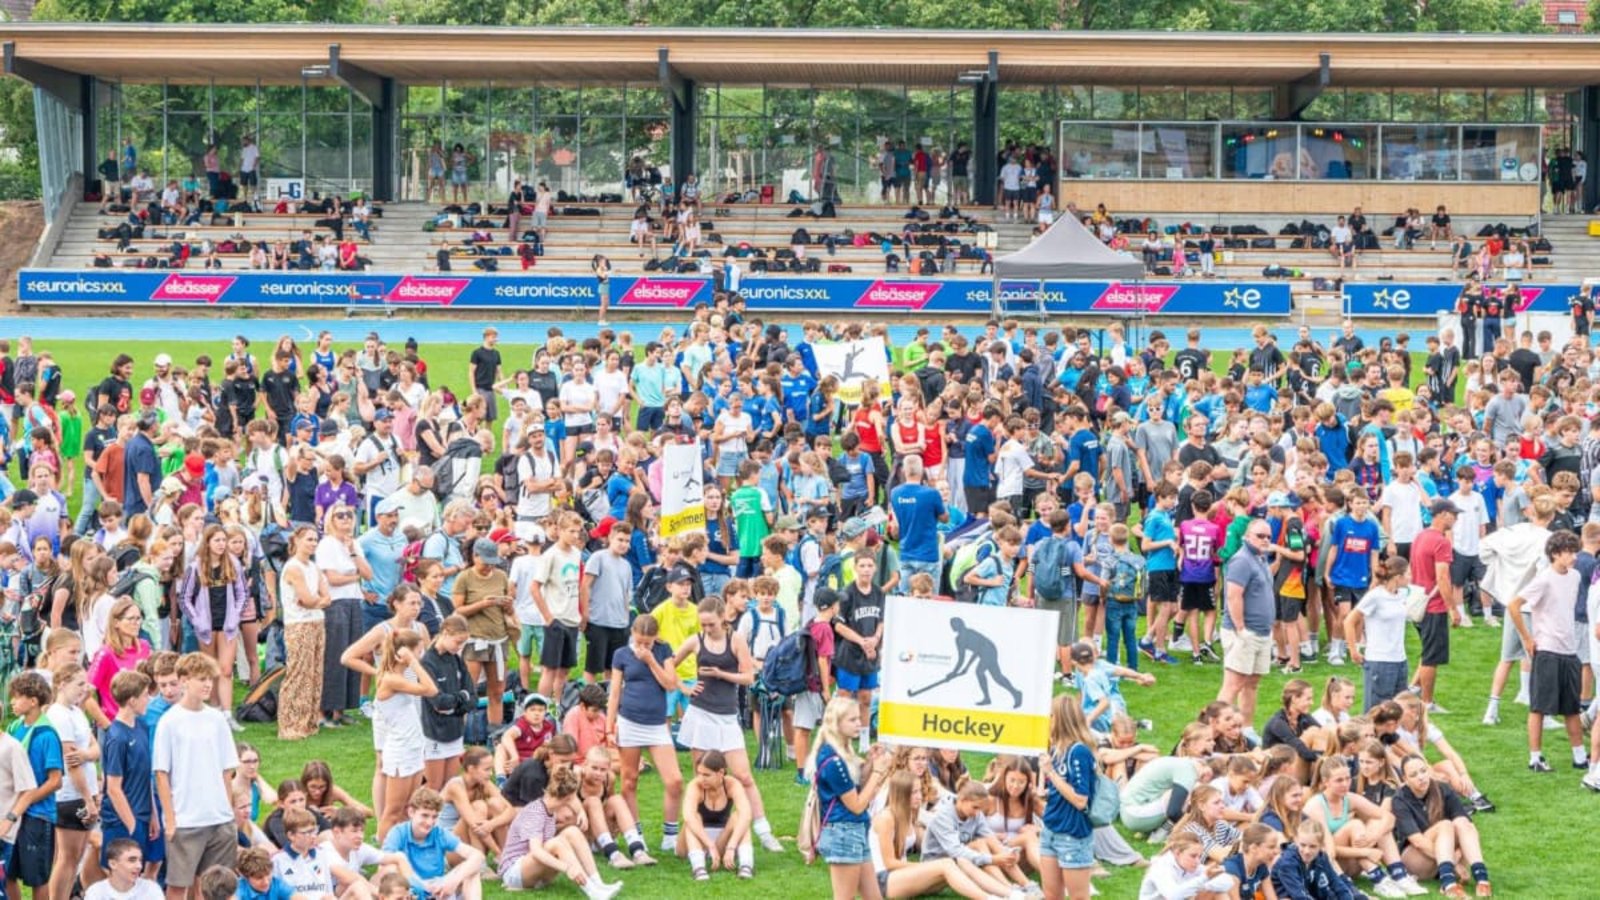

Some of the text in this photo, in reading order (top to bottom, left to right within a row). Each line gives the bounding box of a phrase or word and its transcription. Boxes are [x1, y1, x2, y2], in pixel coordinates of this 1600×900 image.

[164, 280, 220, 295] elsässer
[399, 282, 456, 297] elsässer
[633, 284, 690, 299] elsässer
[869, 286, 926, 301] elsässer
[1105, 288, 1163, 303] elsässer
[1242, 288, 1261, 308] e
[1391, 289, 1411, 309] e
[1180, 360, 1192, 378] 6
[1184, 534, 1211, 560] 26
[922, 713, 1005, 743] Hockey
